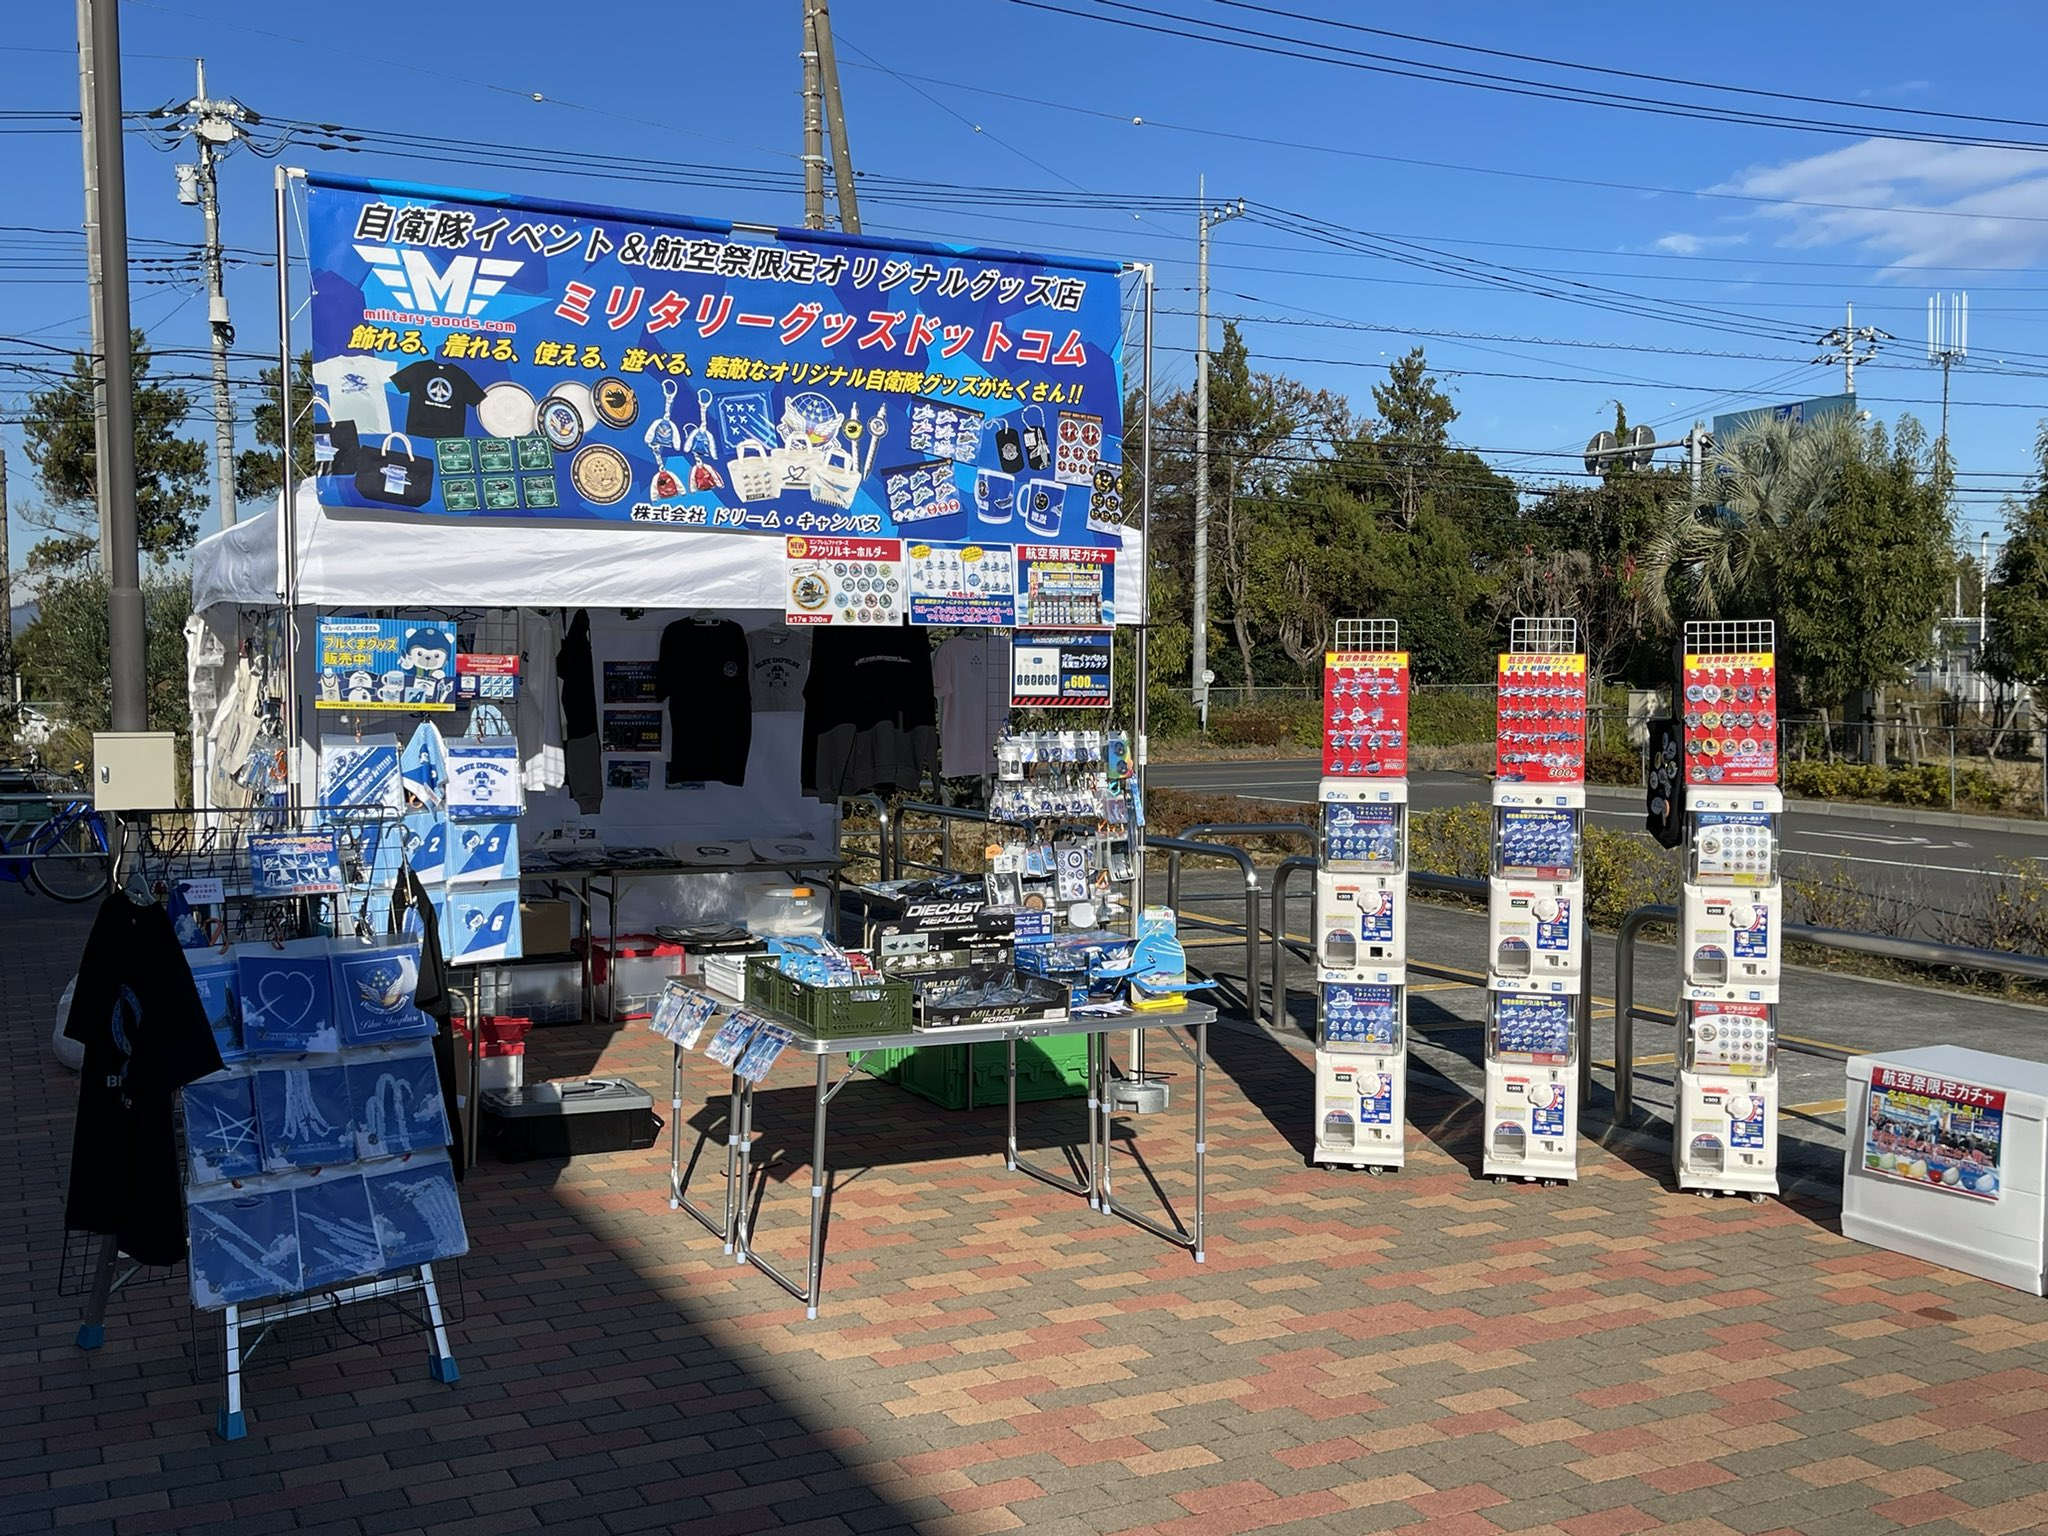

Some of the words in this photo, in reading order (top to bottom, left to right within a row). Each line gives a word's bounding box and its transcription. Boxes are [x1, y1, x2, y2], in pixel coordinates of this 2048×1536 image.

[354, 203, 1085, 312] 自衛隊イベント&航空祭限定オリジナルグッズ店
[363, 308, 517, 334] military-goods.com
[555, 281, 1087, 367] ミリタリーグッズドットコム
[632, 505, 706, 526] 株式会社
[713, 507, 880, 532] ドリーム・キャンバス
[791, 541, 804, 550] NEW
[809, 545, 888, 558] アクリルキーホルダー
[1025, 547, 1108, 561] 航空祭限定ガチャ
[323, 651, 373, 666] 販売中!
[1508, 656, 1578, 664] 航空祭限定ガチャ
[456, 764, 474, 776] BLUE
[475, 762, 509, 777] IMPULSE
[429, 837, 440, 852] 2
[487, 838, 499, 852] 3
[906, 901, 984, 917] DIECAST
[491, 915, 504, 931] 6
[919, 914, 974, 926] REPLICA
[970, 1006, 1030, 1018] MILITARY
[981, 1015, 1016, 1024] FORCE
[1881, 1069, 1995, 1105] 航空祭限定ガチャ
